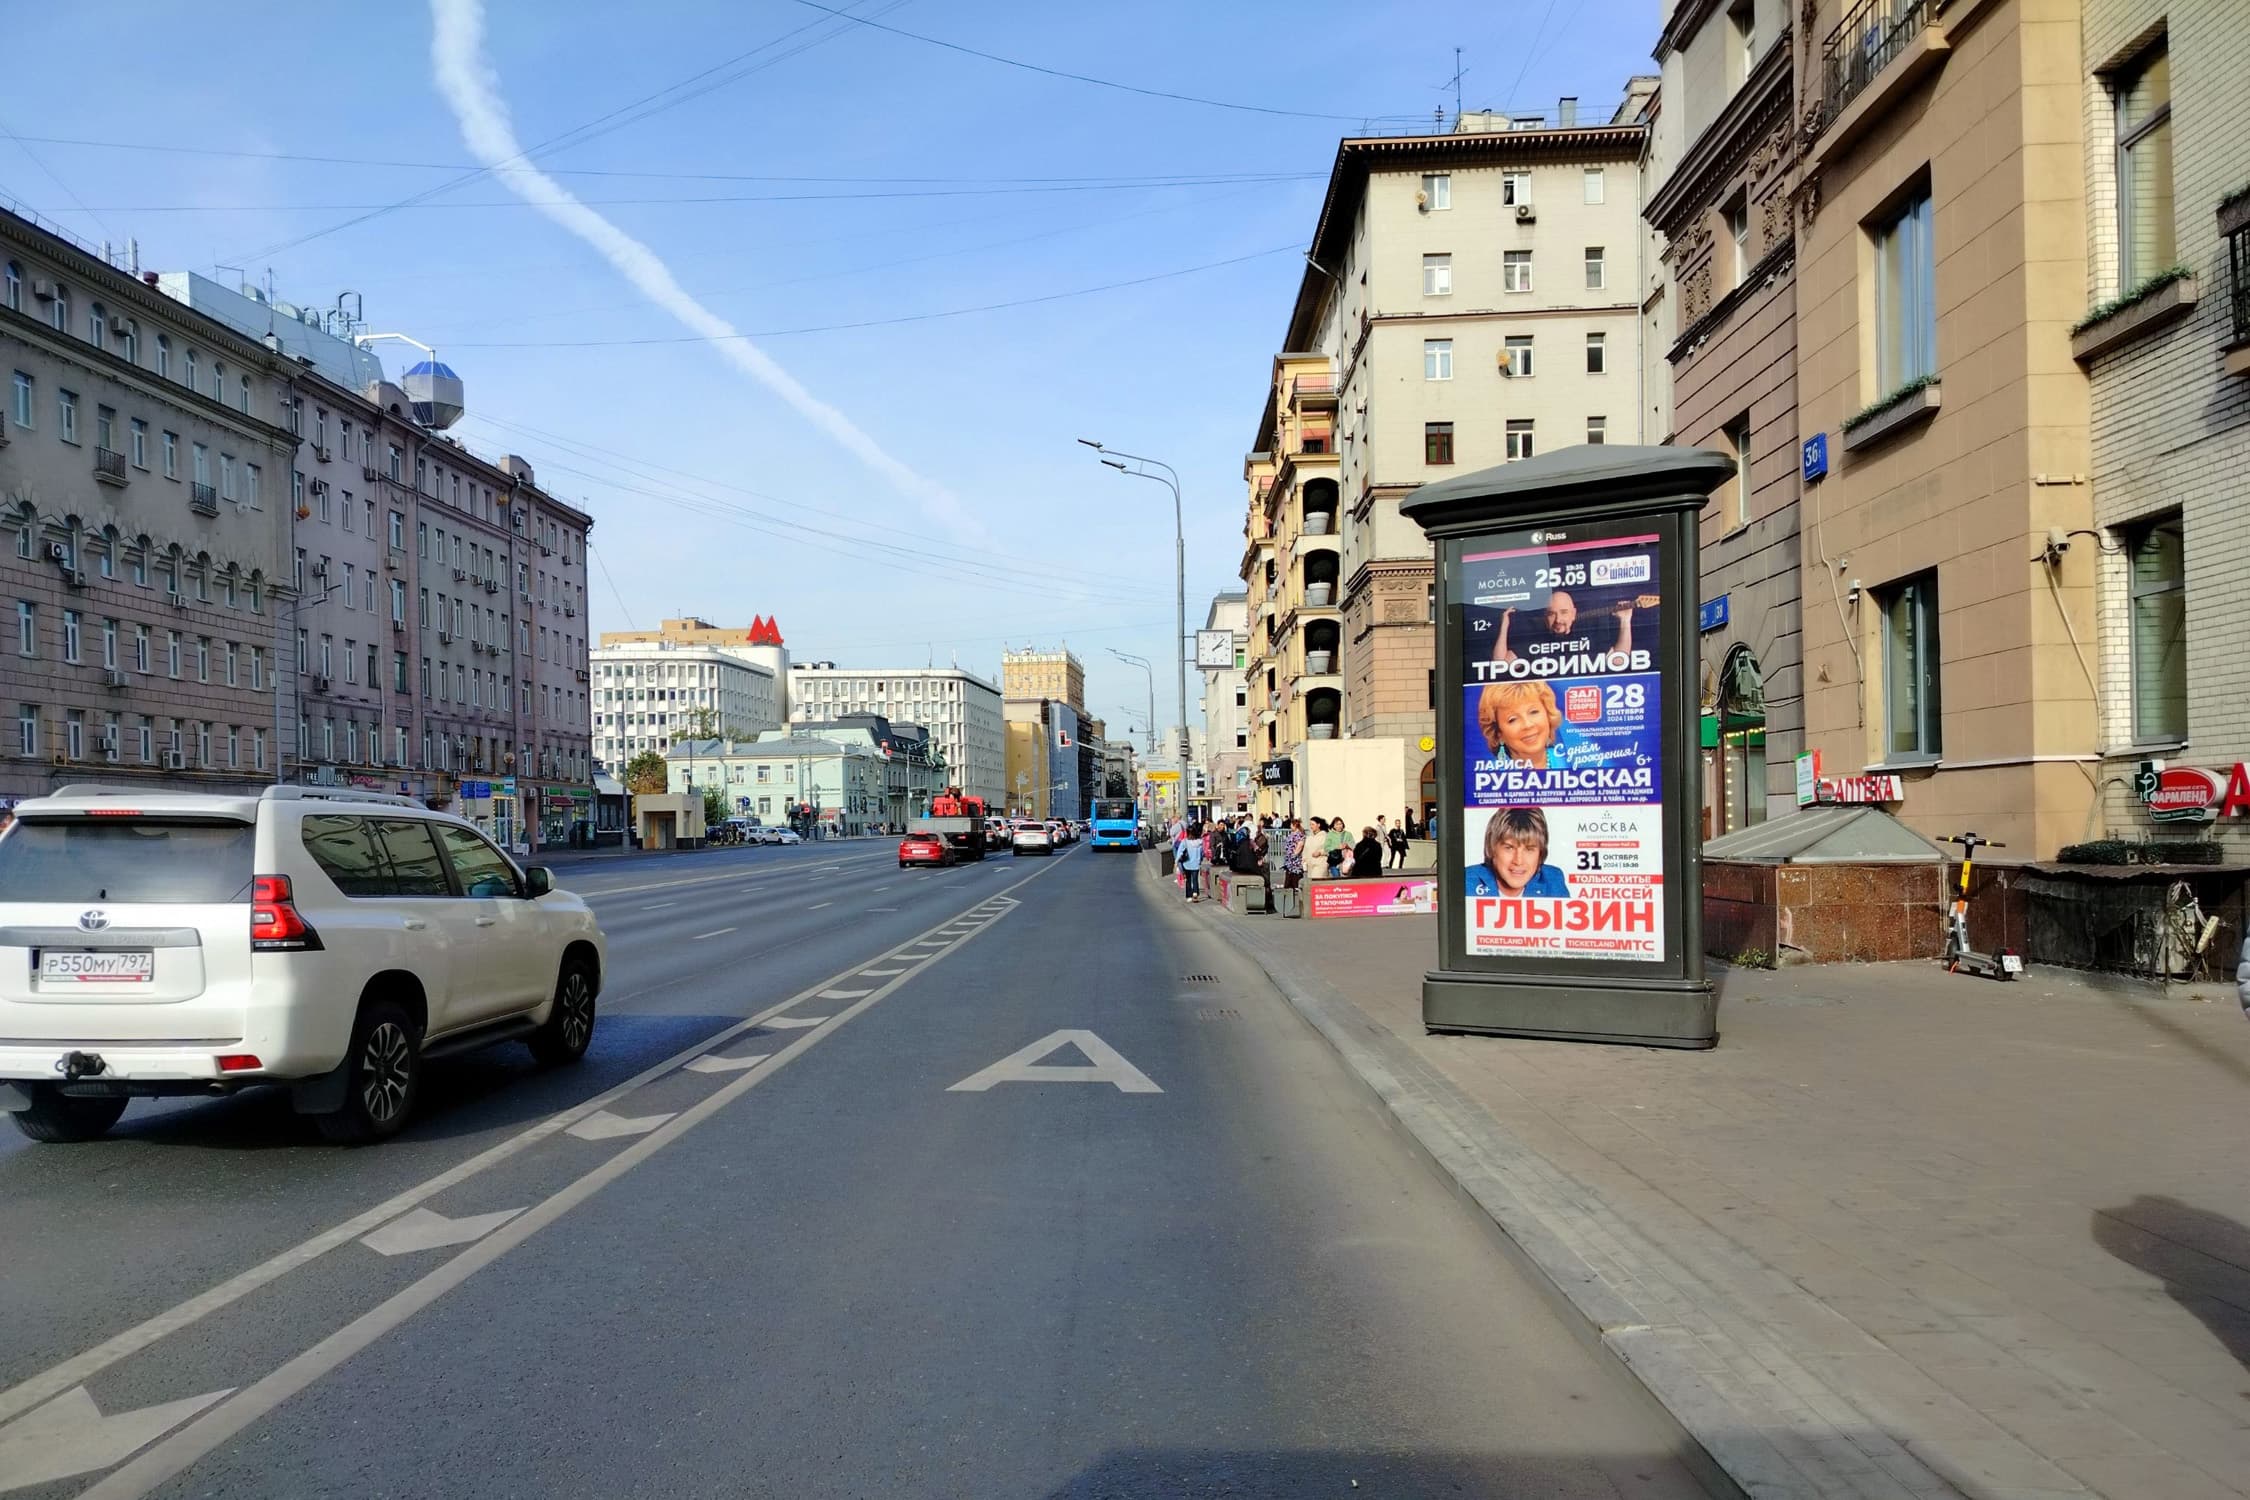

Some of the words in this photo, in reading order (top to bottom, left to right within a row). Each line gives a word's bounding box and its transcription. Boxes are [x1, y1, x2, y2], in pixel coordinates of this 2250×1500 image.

[1805, 442, 1818, 467] 36
[1545, 532, 1567, 541] Russ
[1535, 567, 1586, 589] 25.09
[1609, 566, 1645, 580] ШАНСОН
[1478, 577, 1526, 590] МОСКВА
[1472, 619, 1493, 632] 12+
[1528, 637, 1591, 655] СЕРГЕЙ
[1471, 650, 1652, 680] ТРОФИМОВ
[1569, 689, 1598, 699] ЗАЛ
[1605, 683, 1645, 709] 28
[1606, 708, 1645, 716] СЕНТЯБРЯ
[1553, 743, 1566, 757] С
[1566, 741, 1600, 762] днём
[1572, 741, 1638, 771] рождения!
[1474, 759, 1535, 771] ЛАРИСА
[1636, 754, 1652, 766] 6+
[1475, 768, 1652, 791] РУБАЛЬСКАЯ
[1835, 775, 1895, 802] АПТЕКА
[2150, 790, 2207, 804] ФАРМЛЕНД
[1577, 822, 1638, 832] МОСКВА
[1577, 851, 1602, 870] 31
[1576, 875, 1616, 883] ТОЛЬКО
[1475, 884, 1491, 896] 6+
[1578, 885, 1653, 899] АЛЕКСЕЙ
[1475, 898, 1655, 932] ГЛЫЗИН
[1479, 937, 1524, 945] TICKETLAND
[1524, 937, 1561, 948] МТС
[1567, 940, 1616, 948] TICKETLAND
[1617, 939, 1655, 951] МТС
[48, 955, 116, 973] Р550МУ
[120, 954, 147, 969] 797
